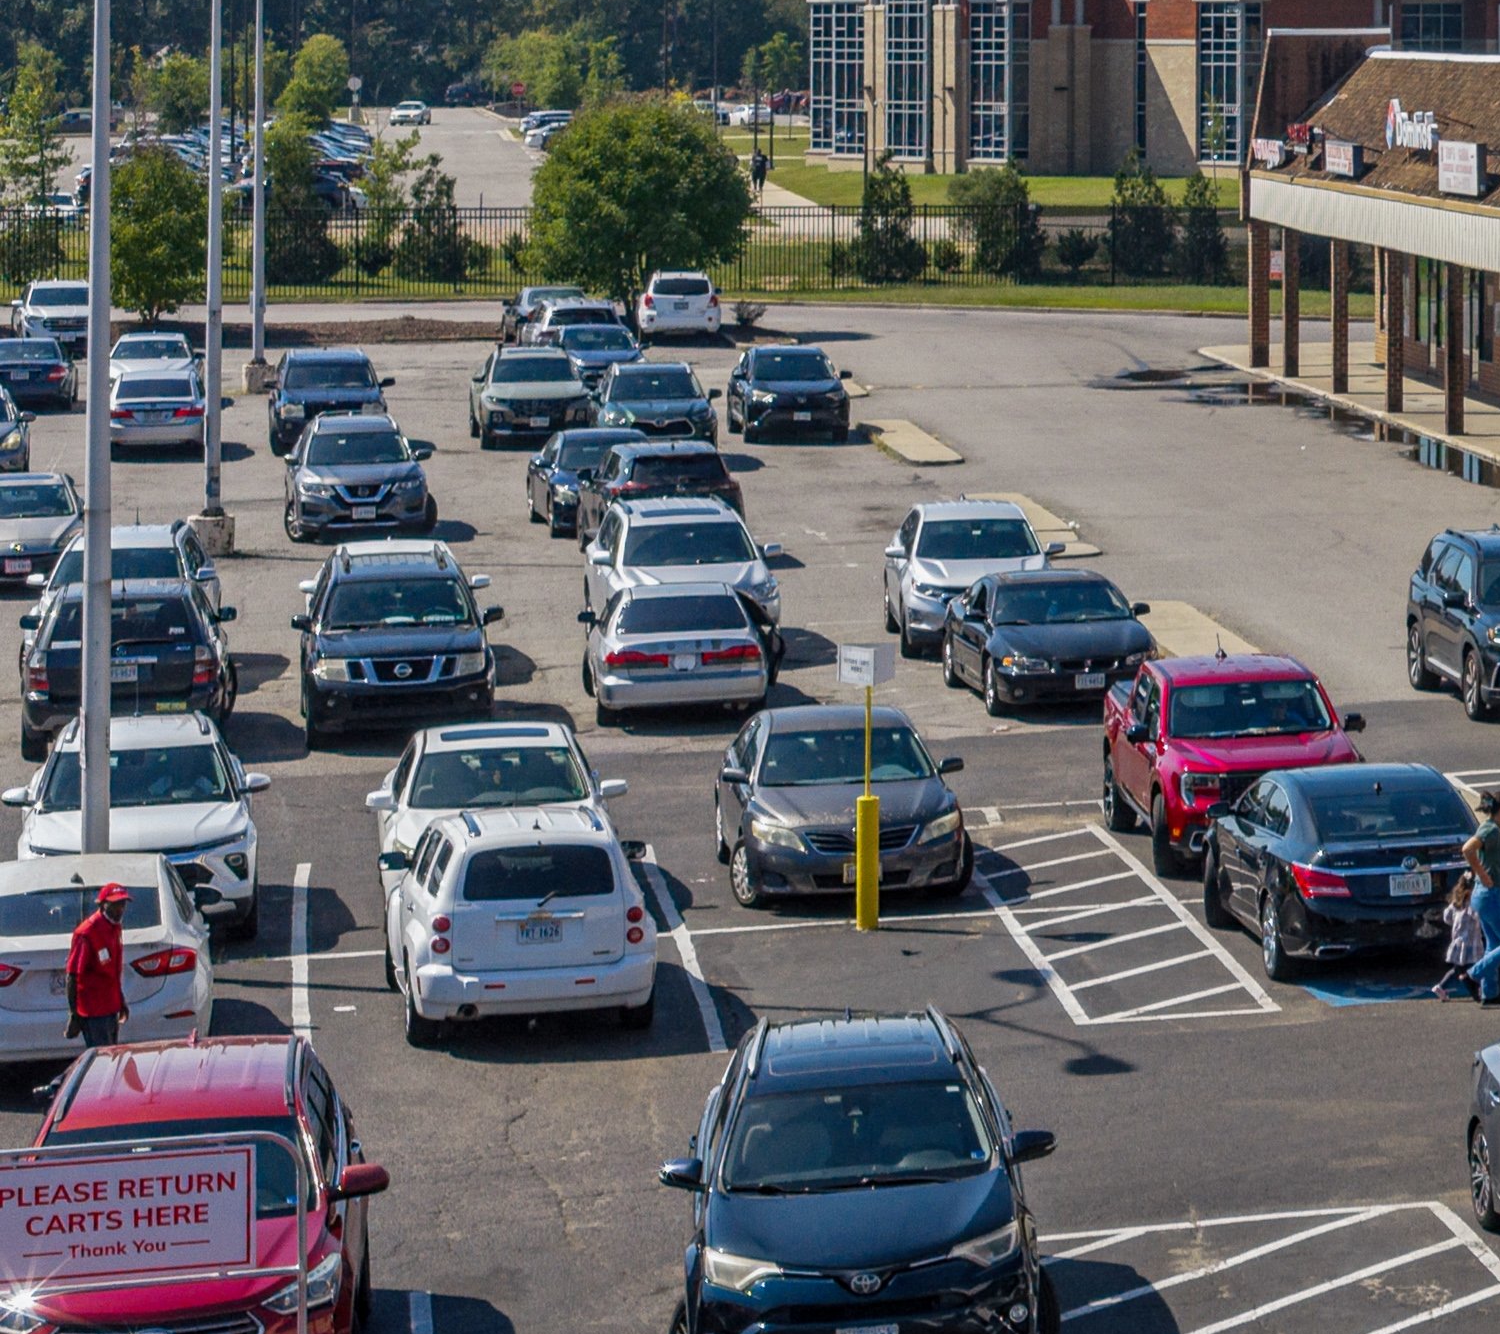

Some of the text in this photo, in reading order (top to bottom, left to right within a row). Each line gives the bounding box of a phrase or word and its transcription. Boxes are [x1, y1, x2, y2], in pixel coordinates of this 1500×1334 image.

[0, 1171, 236, 1209] PLEASE RETURN
[25, 1203, 210, 1236] CARTS HERE
[68, 1239, 166, 1259] Thank You
